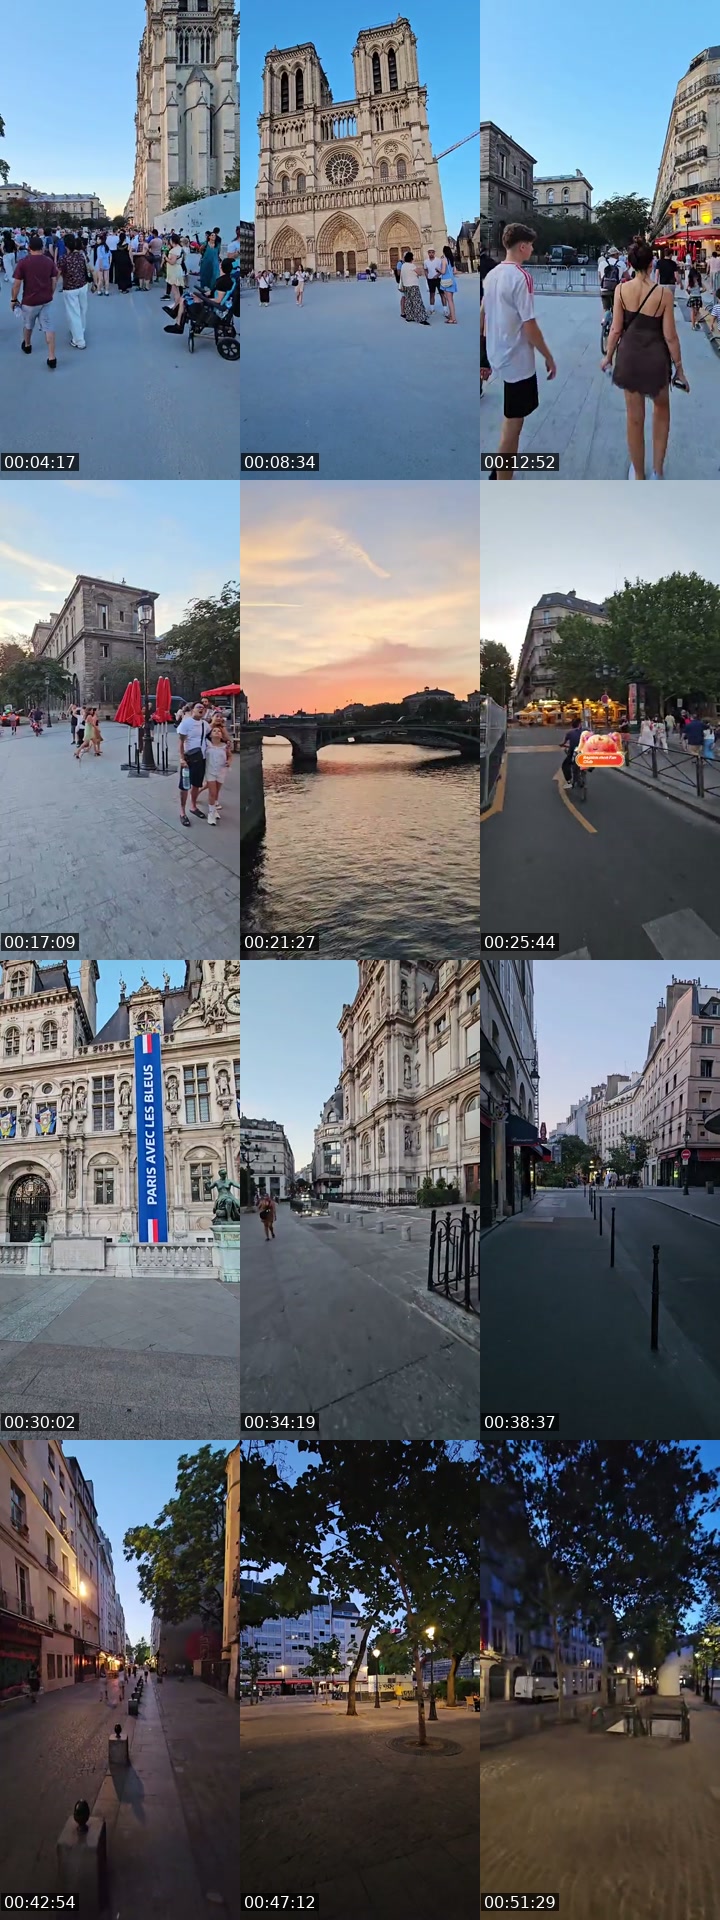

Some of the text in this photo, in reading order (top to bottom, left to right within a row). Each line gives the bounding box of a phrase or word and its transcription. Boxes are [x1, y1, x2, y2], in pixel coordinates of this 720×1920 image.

[143, 1064, 158, 1206] PARIS AVEC LES BLEUS
